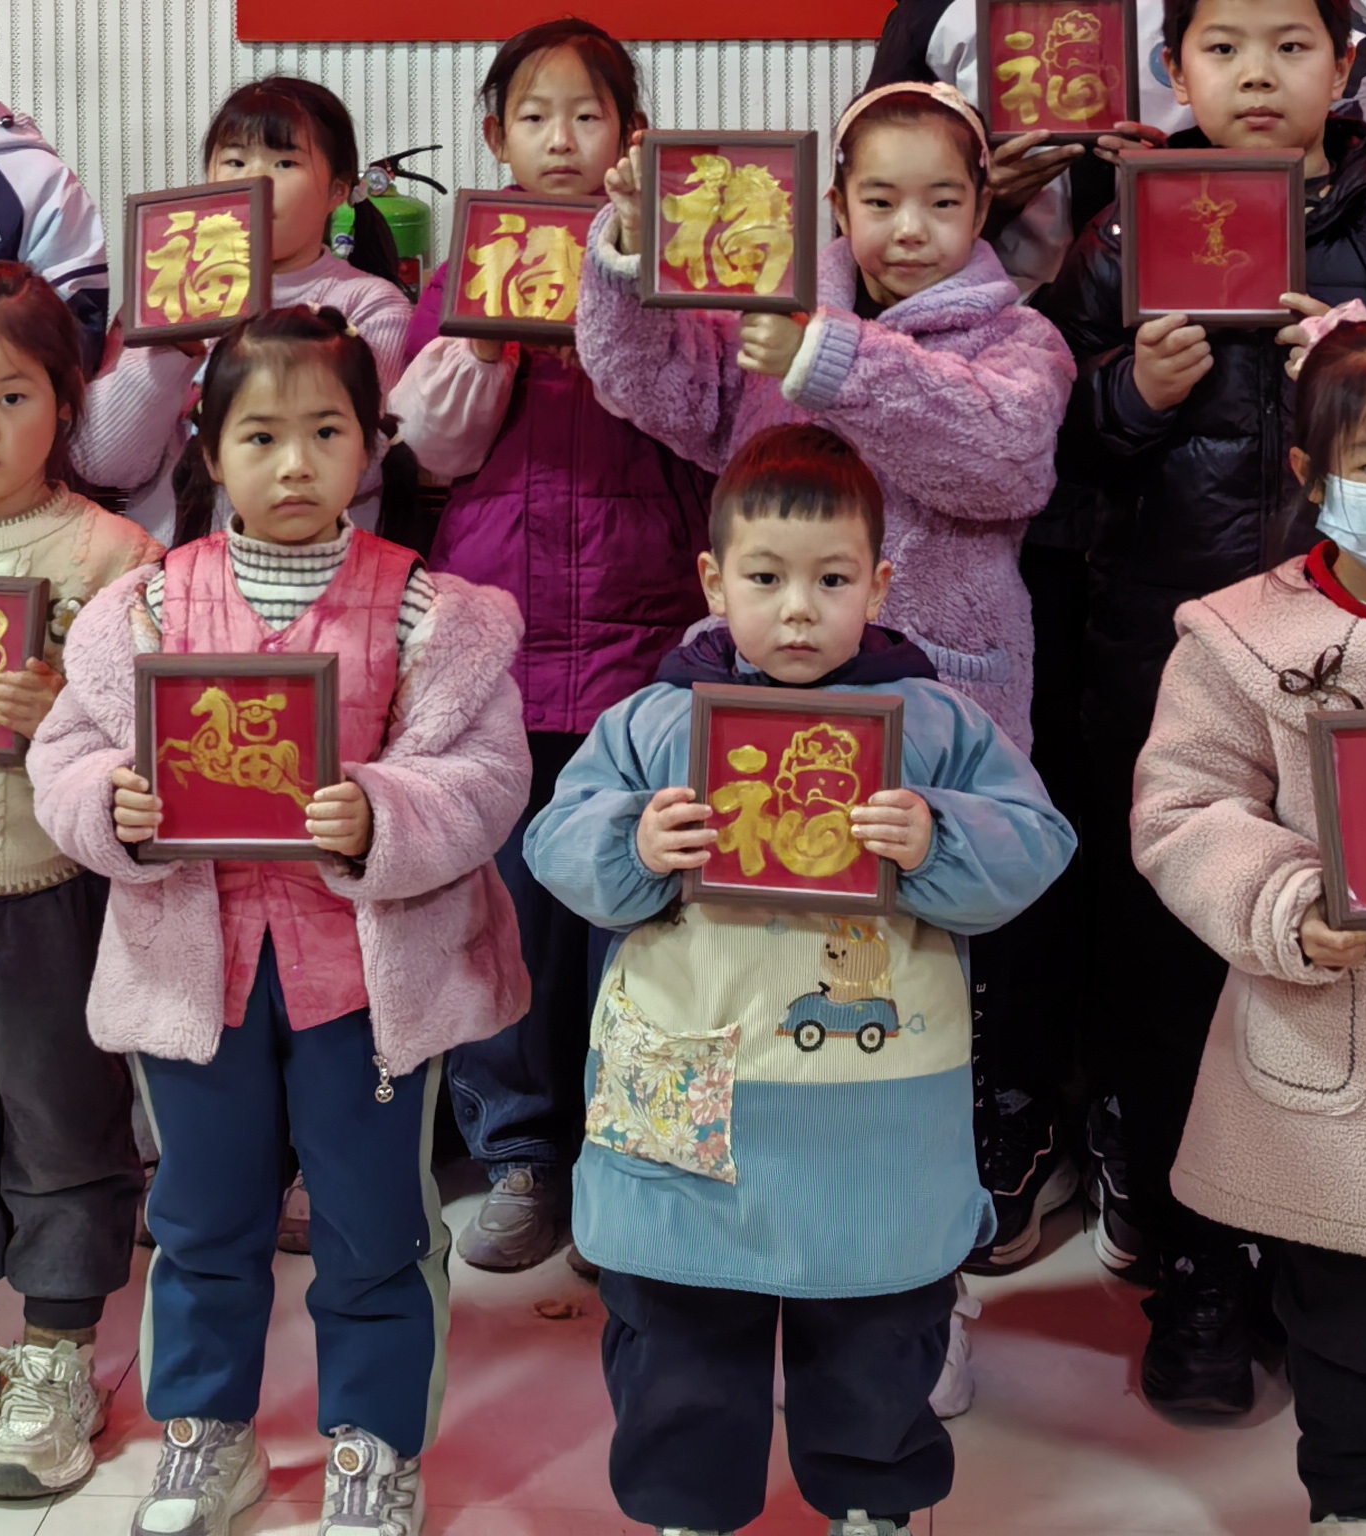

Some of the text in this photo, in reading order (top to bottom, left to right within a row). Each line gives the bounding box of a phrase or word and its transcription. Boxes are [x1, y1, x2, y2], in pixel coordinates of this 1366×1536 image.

[145, 211, 252, 324] 福
[465, 213, 587, 321] 福
[661, 154, 795, 295] 福
